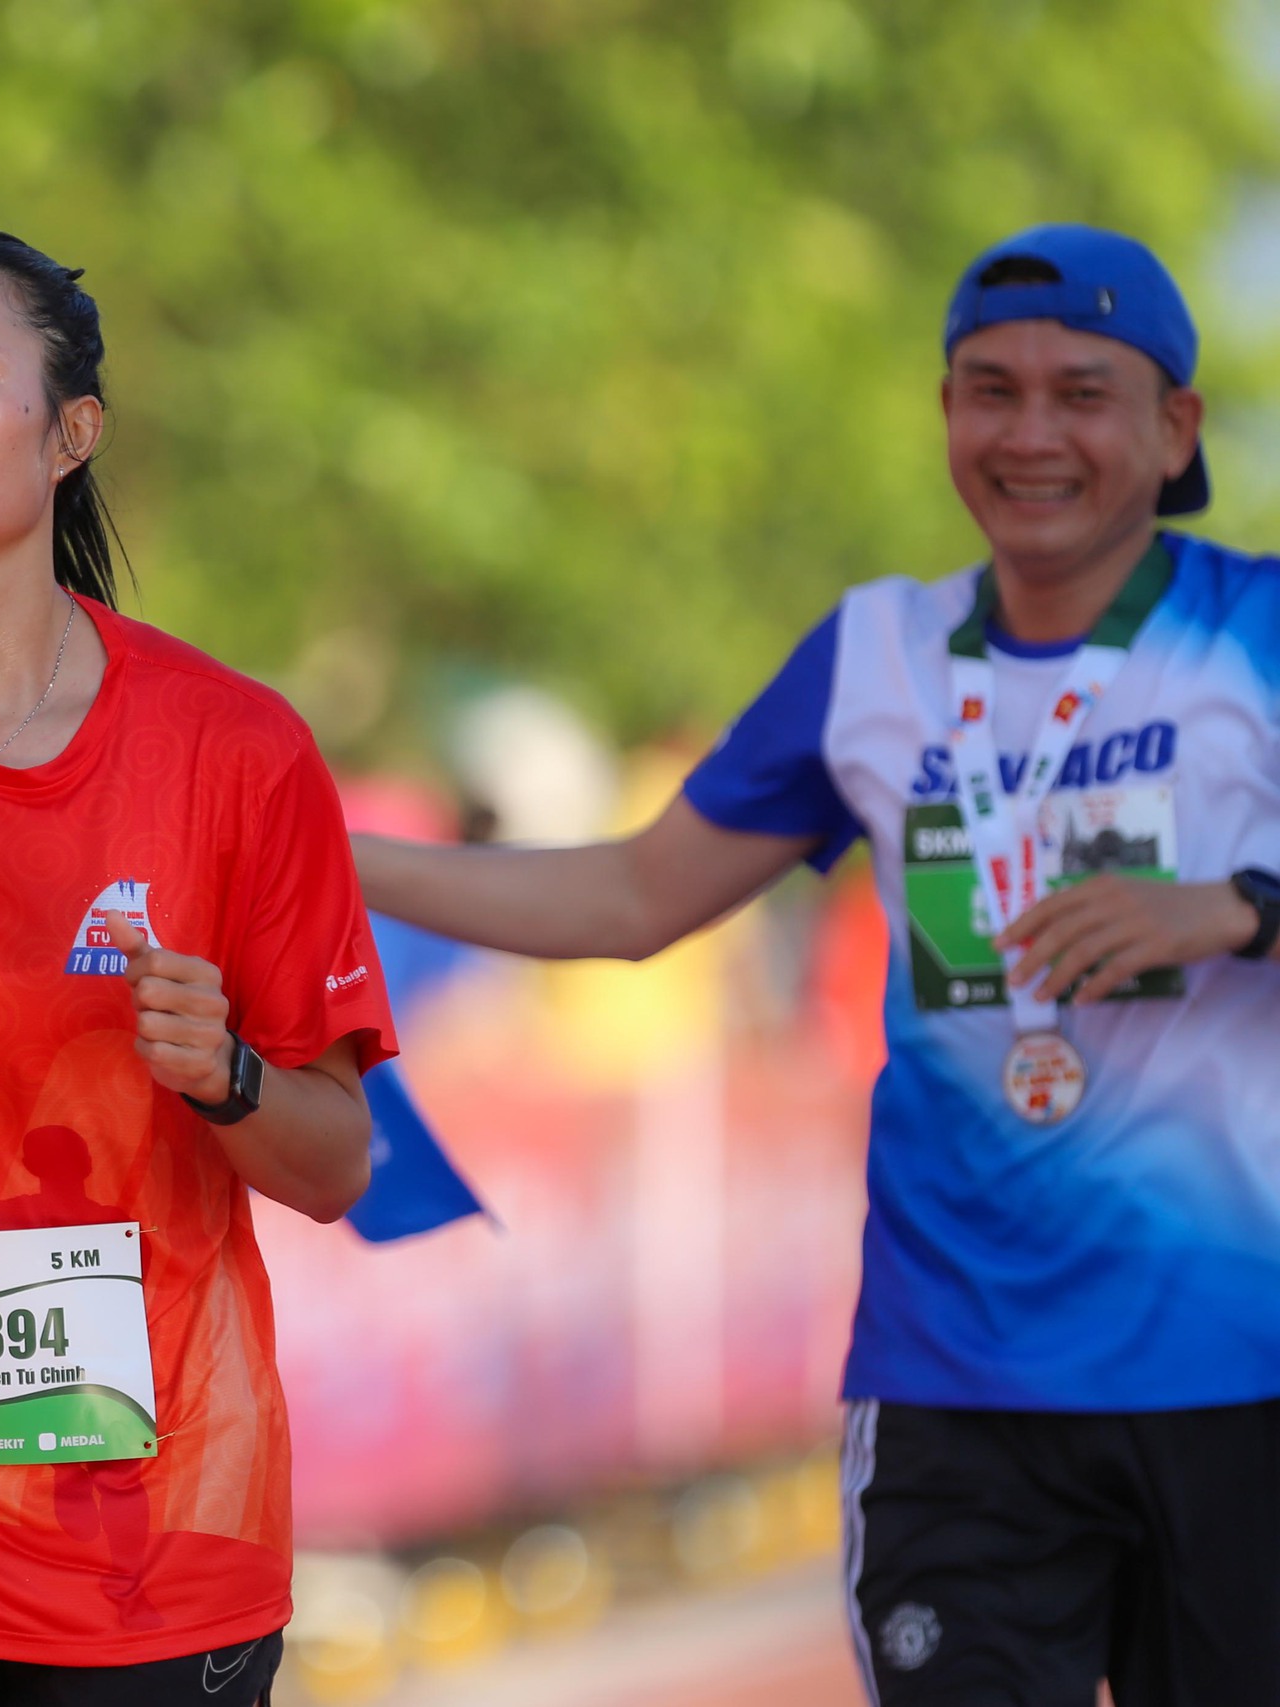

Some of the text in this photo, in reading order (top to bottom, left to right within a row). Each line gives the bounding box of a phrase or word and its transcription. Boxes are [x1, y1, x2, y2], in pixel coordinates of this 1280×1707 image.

[912, 721, 1176, 795] SWACO
[50, 1249, 101, 1270] 5 KM
[16, 1367, 35, 1385] Tú
[41, 1365, 86, 1383] Chinh
[60, 1435, 105, 1448] MEDAL
